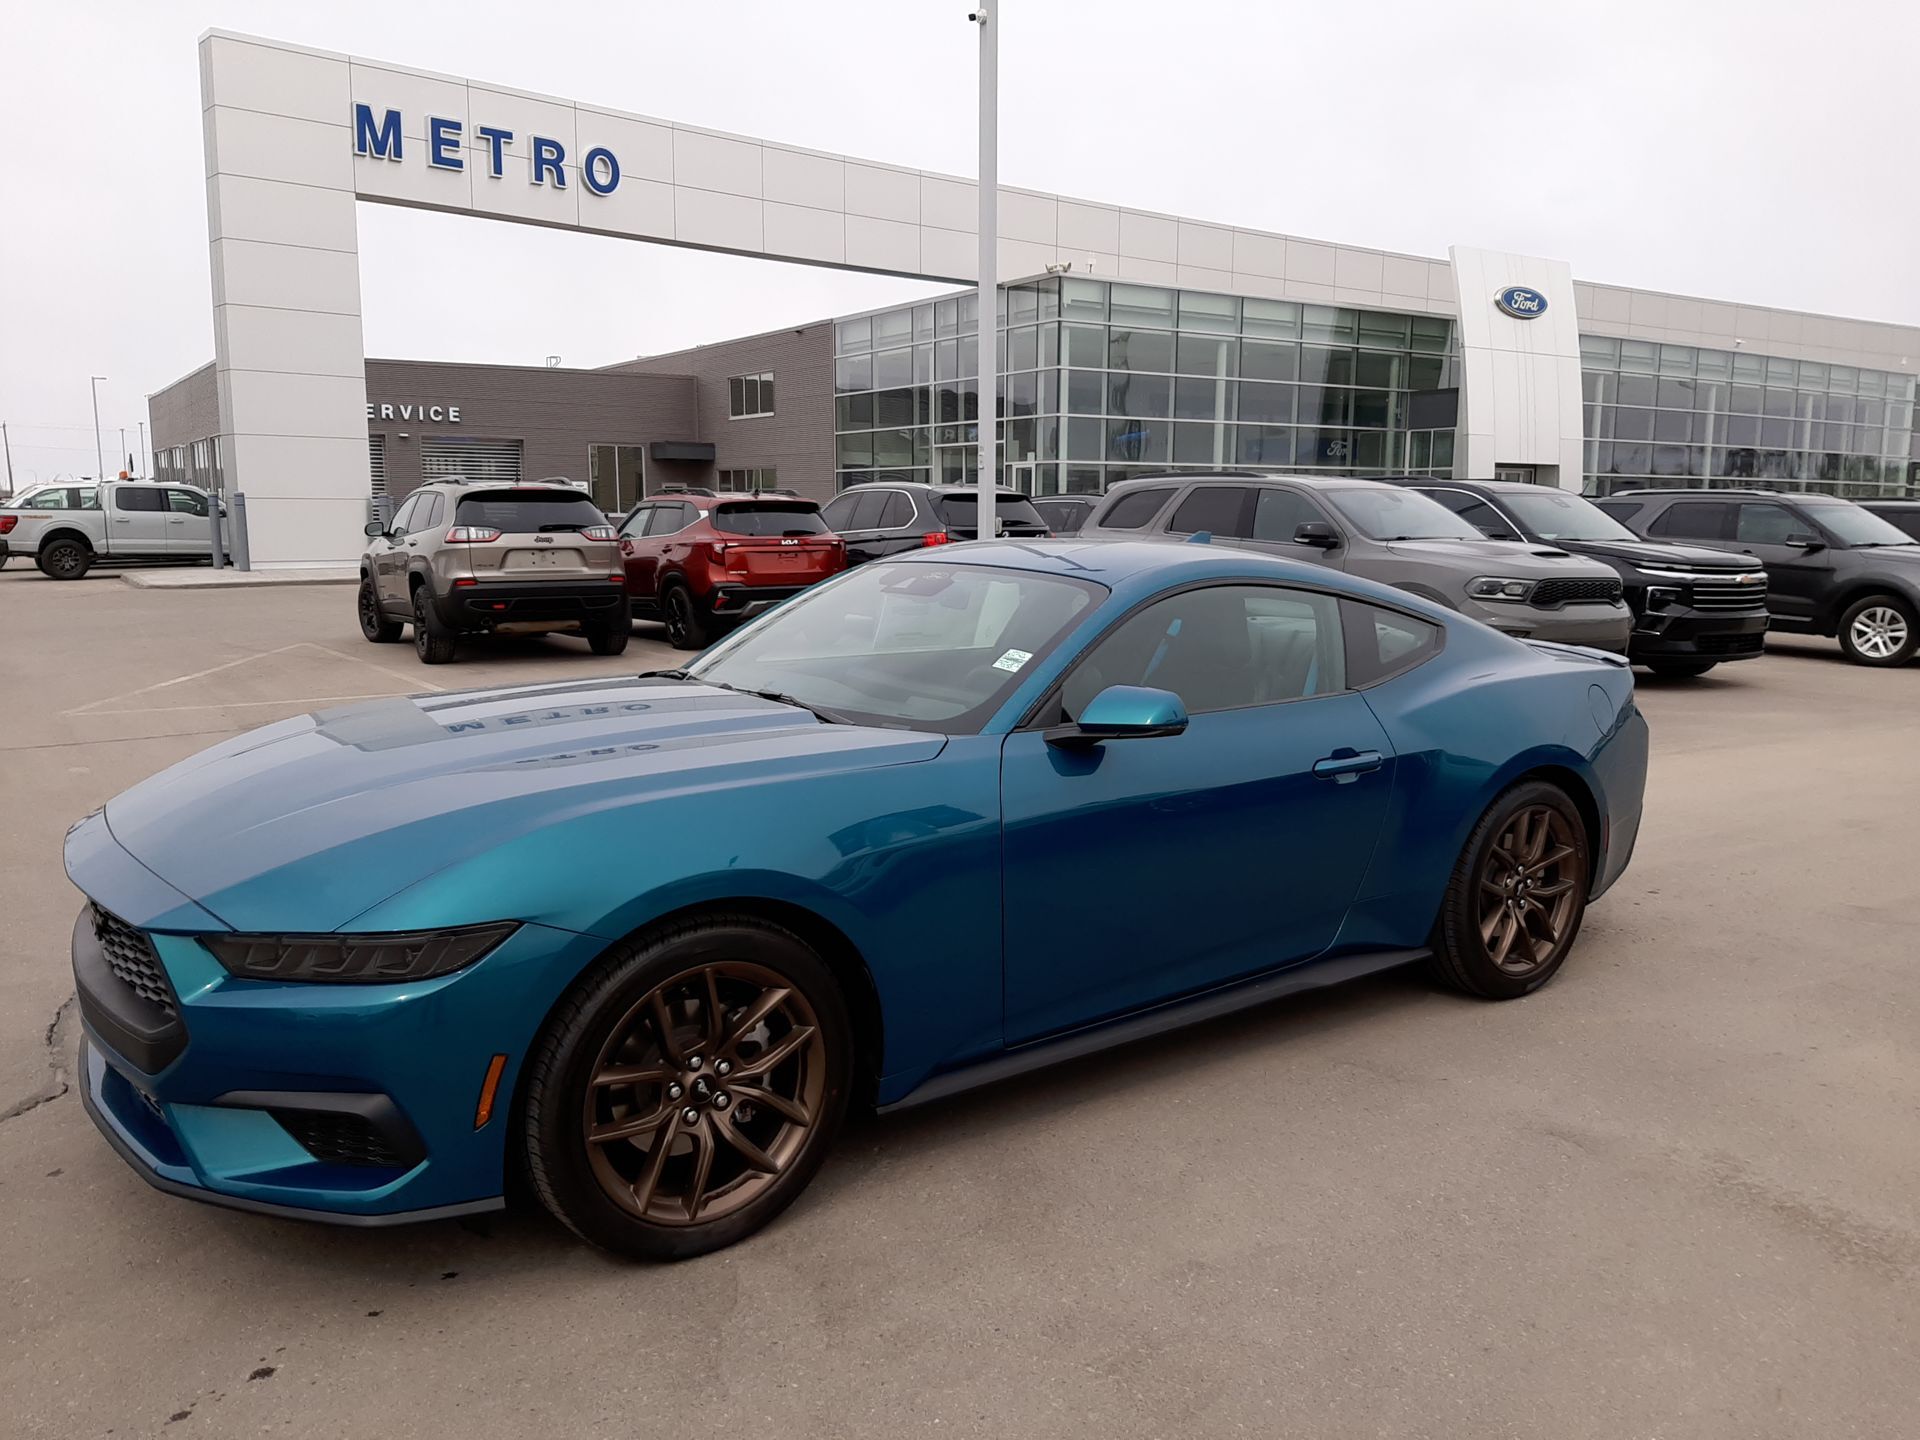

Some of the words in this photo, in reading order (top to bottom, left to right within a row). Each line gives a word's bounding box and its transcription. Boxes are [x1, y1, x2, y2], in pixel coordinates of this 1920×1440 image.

[354, 101, 621, 196] METRO
[1511, 291, 1539, 312] Ford
[366, 403, 460, 422] ERVICE
